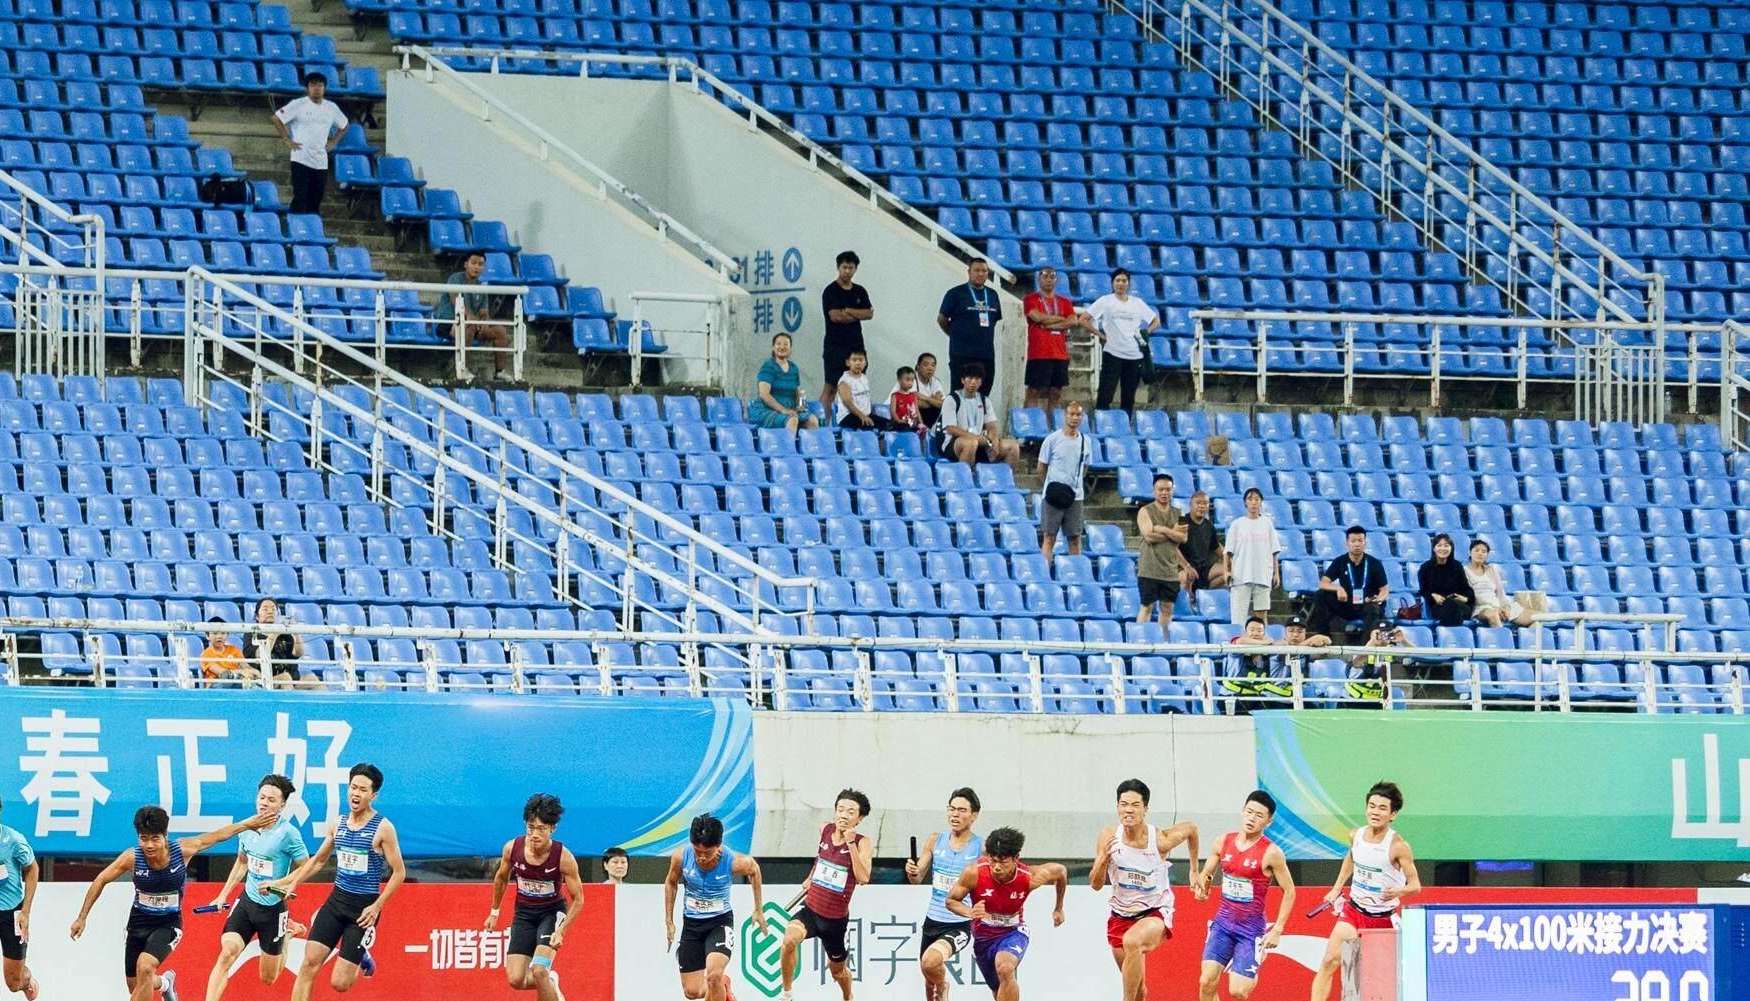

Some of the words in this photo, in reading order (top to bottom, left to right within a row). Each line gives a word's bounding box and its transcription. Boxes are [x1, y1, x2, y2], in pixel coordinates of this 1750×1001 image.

[404, 927, 512, 970] 一切皆有
[1432, 911, 1708, 955] 男子4x100米接力决赛
